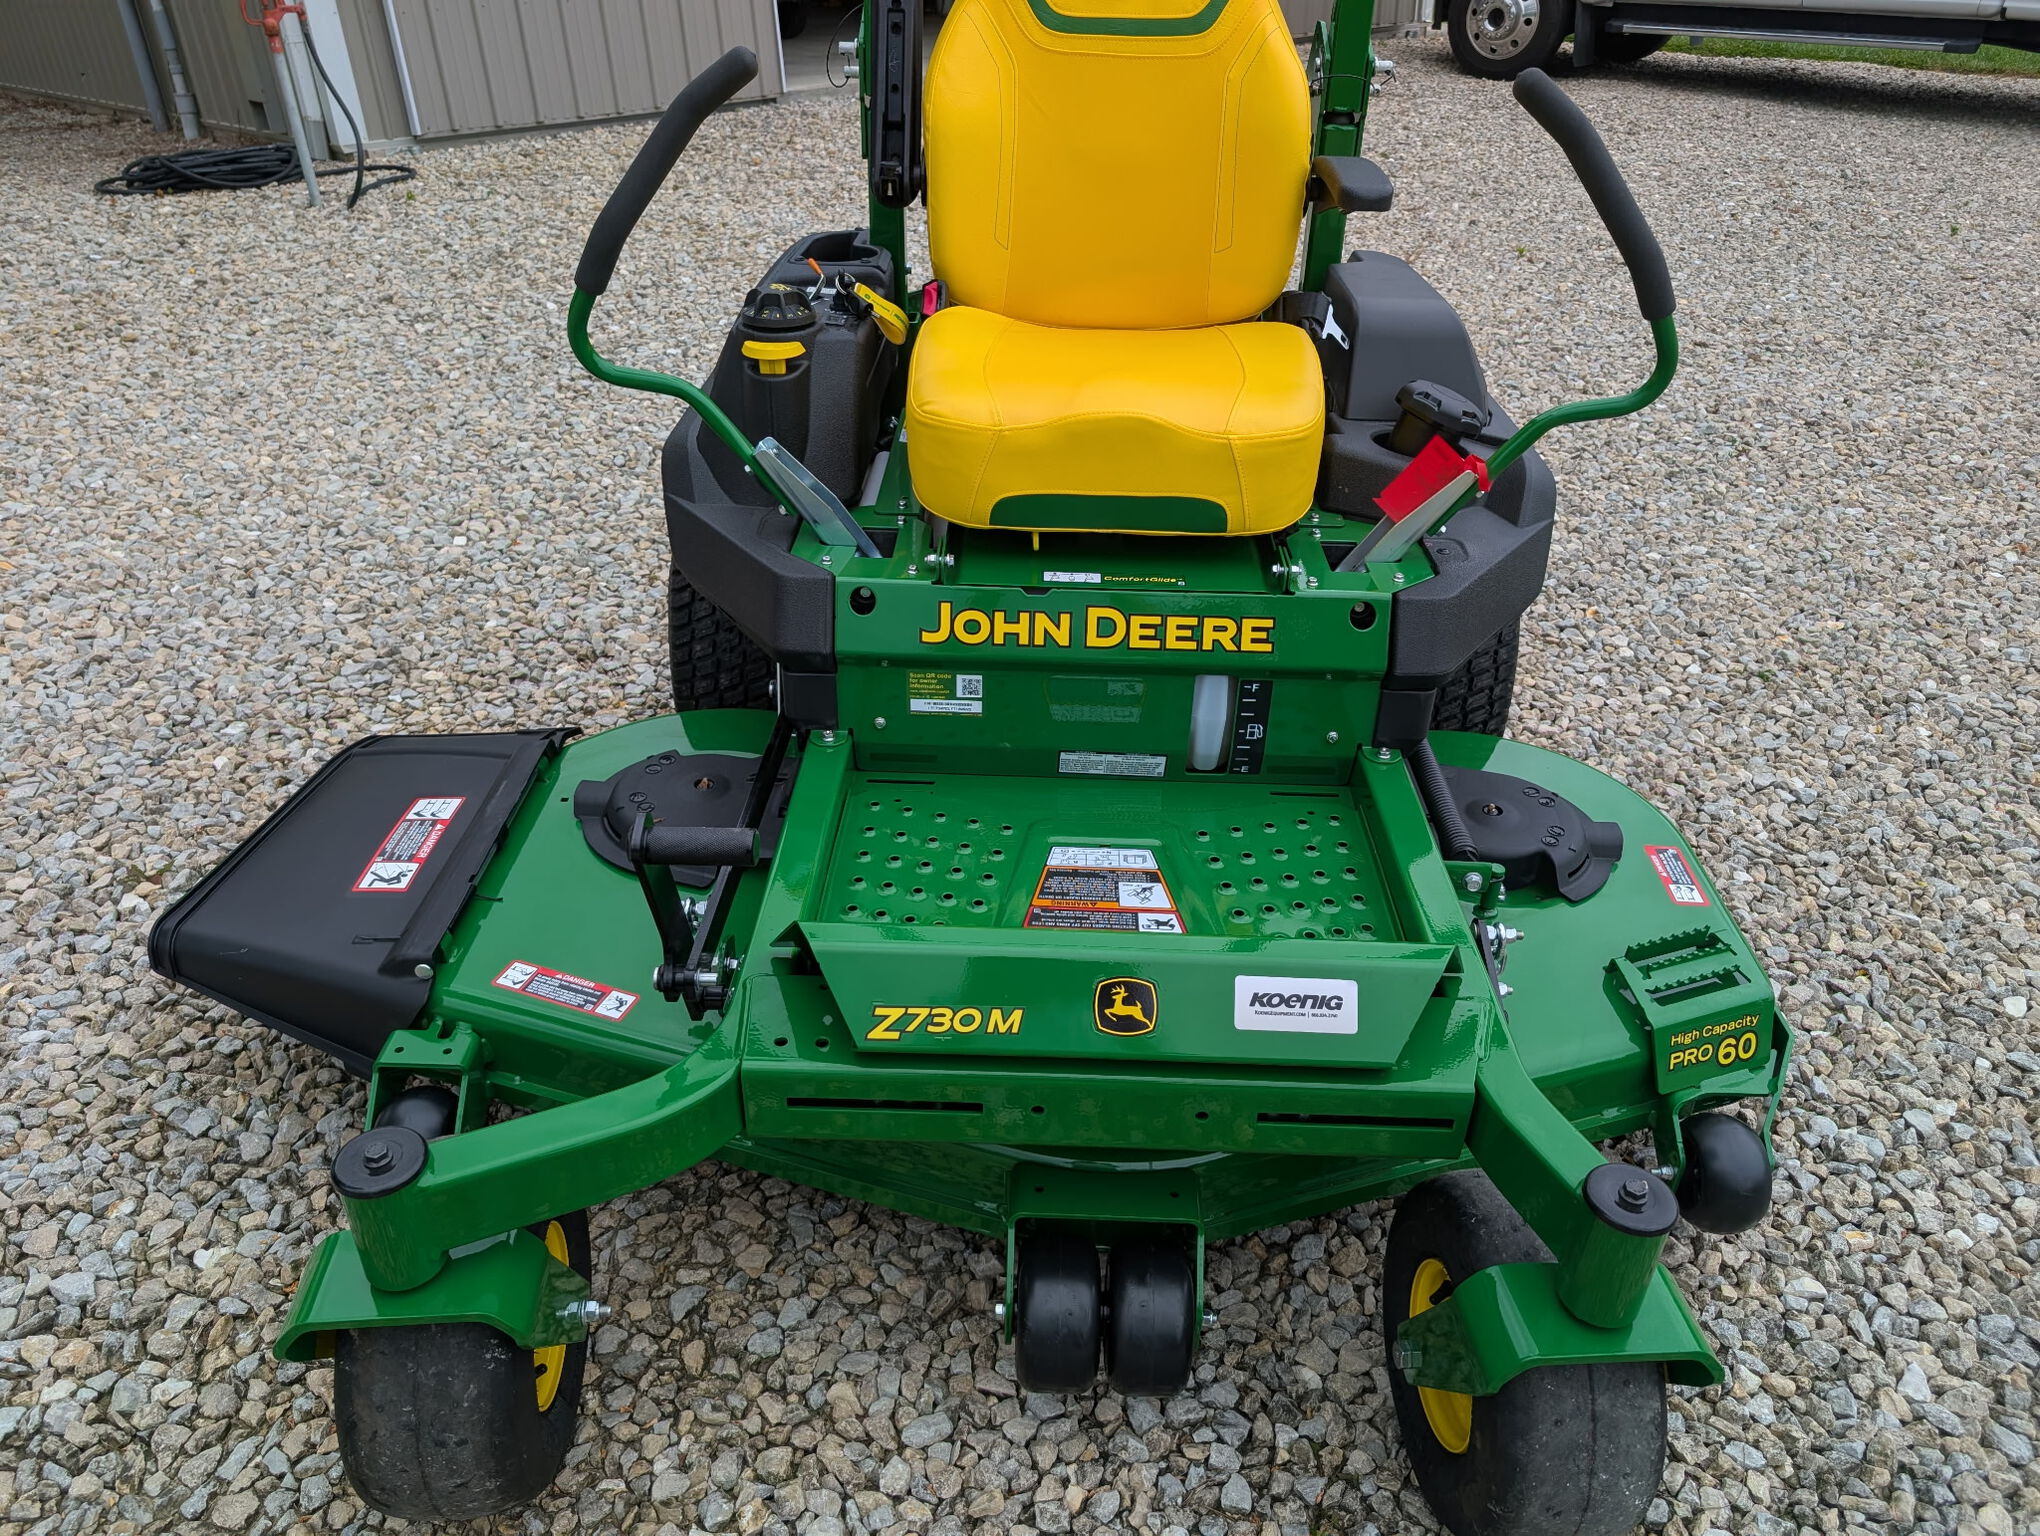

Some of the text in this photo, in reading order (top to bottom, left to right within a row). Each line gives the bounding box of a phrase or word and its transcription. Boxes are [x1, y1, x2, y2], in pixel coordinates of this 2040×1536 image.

[918, 600, 1276, 654] JOHN DEERE
[1252, 683, 1261, 693] F
[1241, 765, 1249, 773] E
[416, 830, 442, 859] DANGER
[562, 974, 596, 988] DANGER
[865, 1004, 1025, 1041] Z730 M
[1670, 1014, 1760, 1047] High Capacity
[1668, 1031, 1758, 1072] PRO 60
